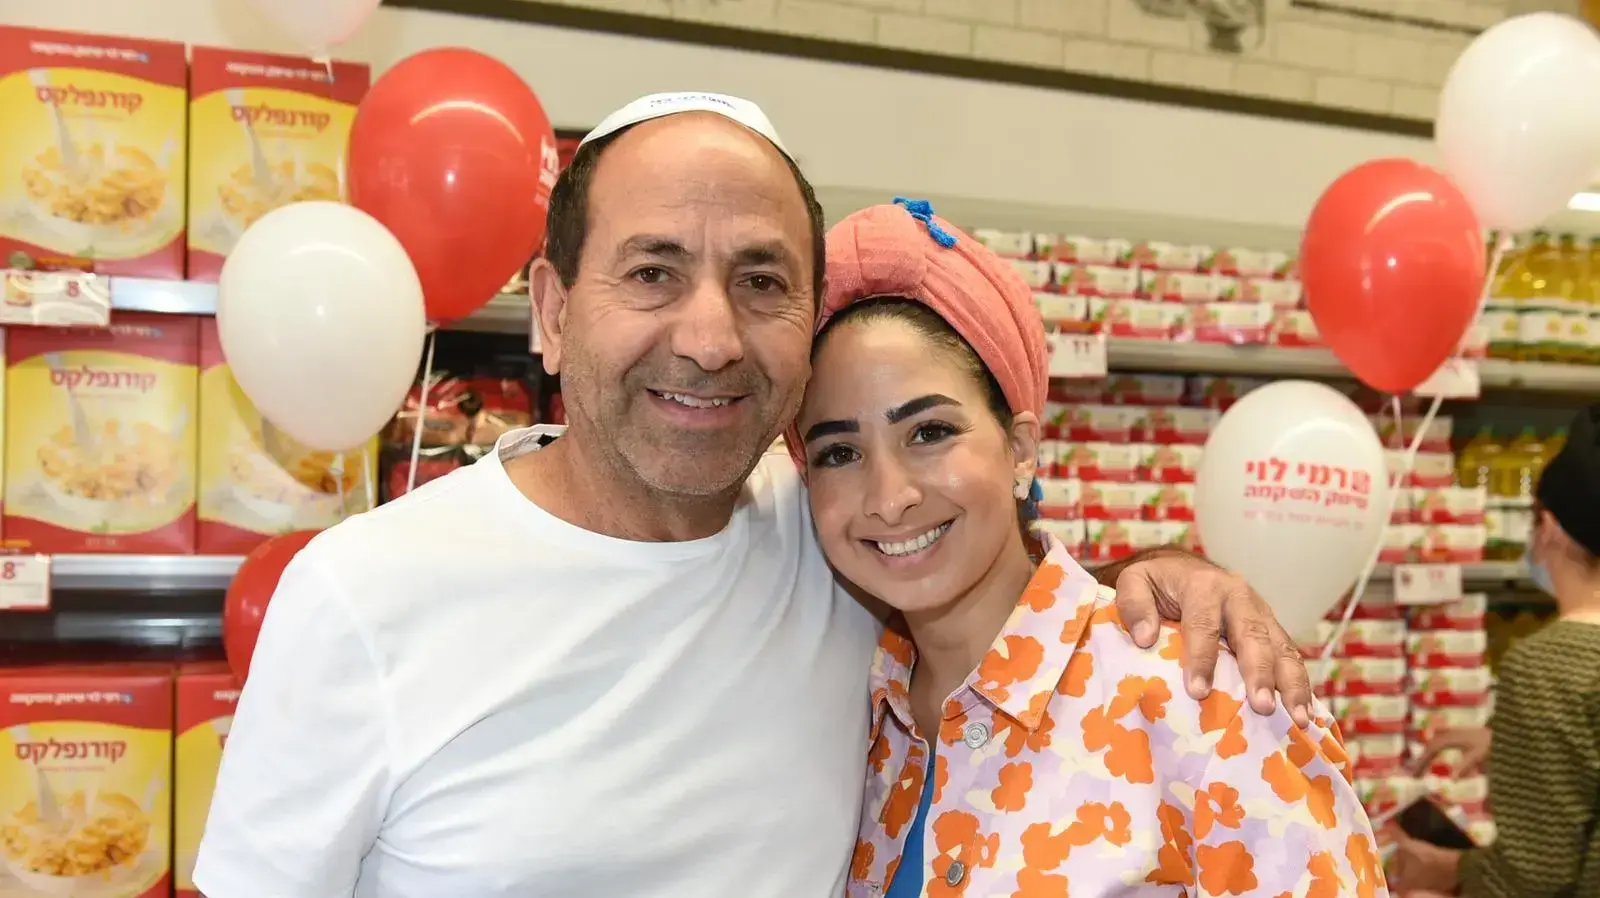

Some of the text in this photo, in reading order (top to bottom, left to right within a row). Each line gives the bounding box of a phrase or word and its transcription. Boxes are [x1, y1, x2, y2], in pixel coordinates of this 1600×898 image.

[50, 365, 156, 393] קורנפלקס
[1246, 456, 1347, 488] רמי לוי
[15, 738, 126, 765] קורנפלקס
